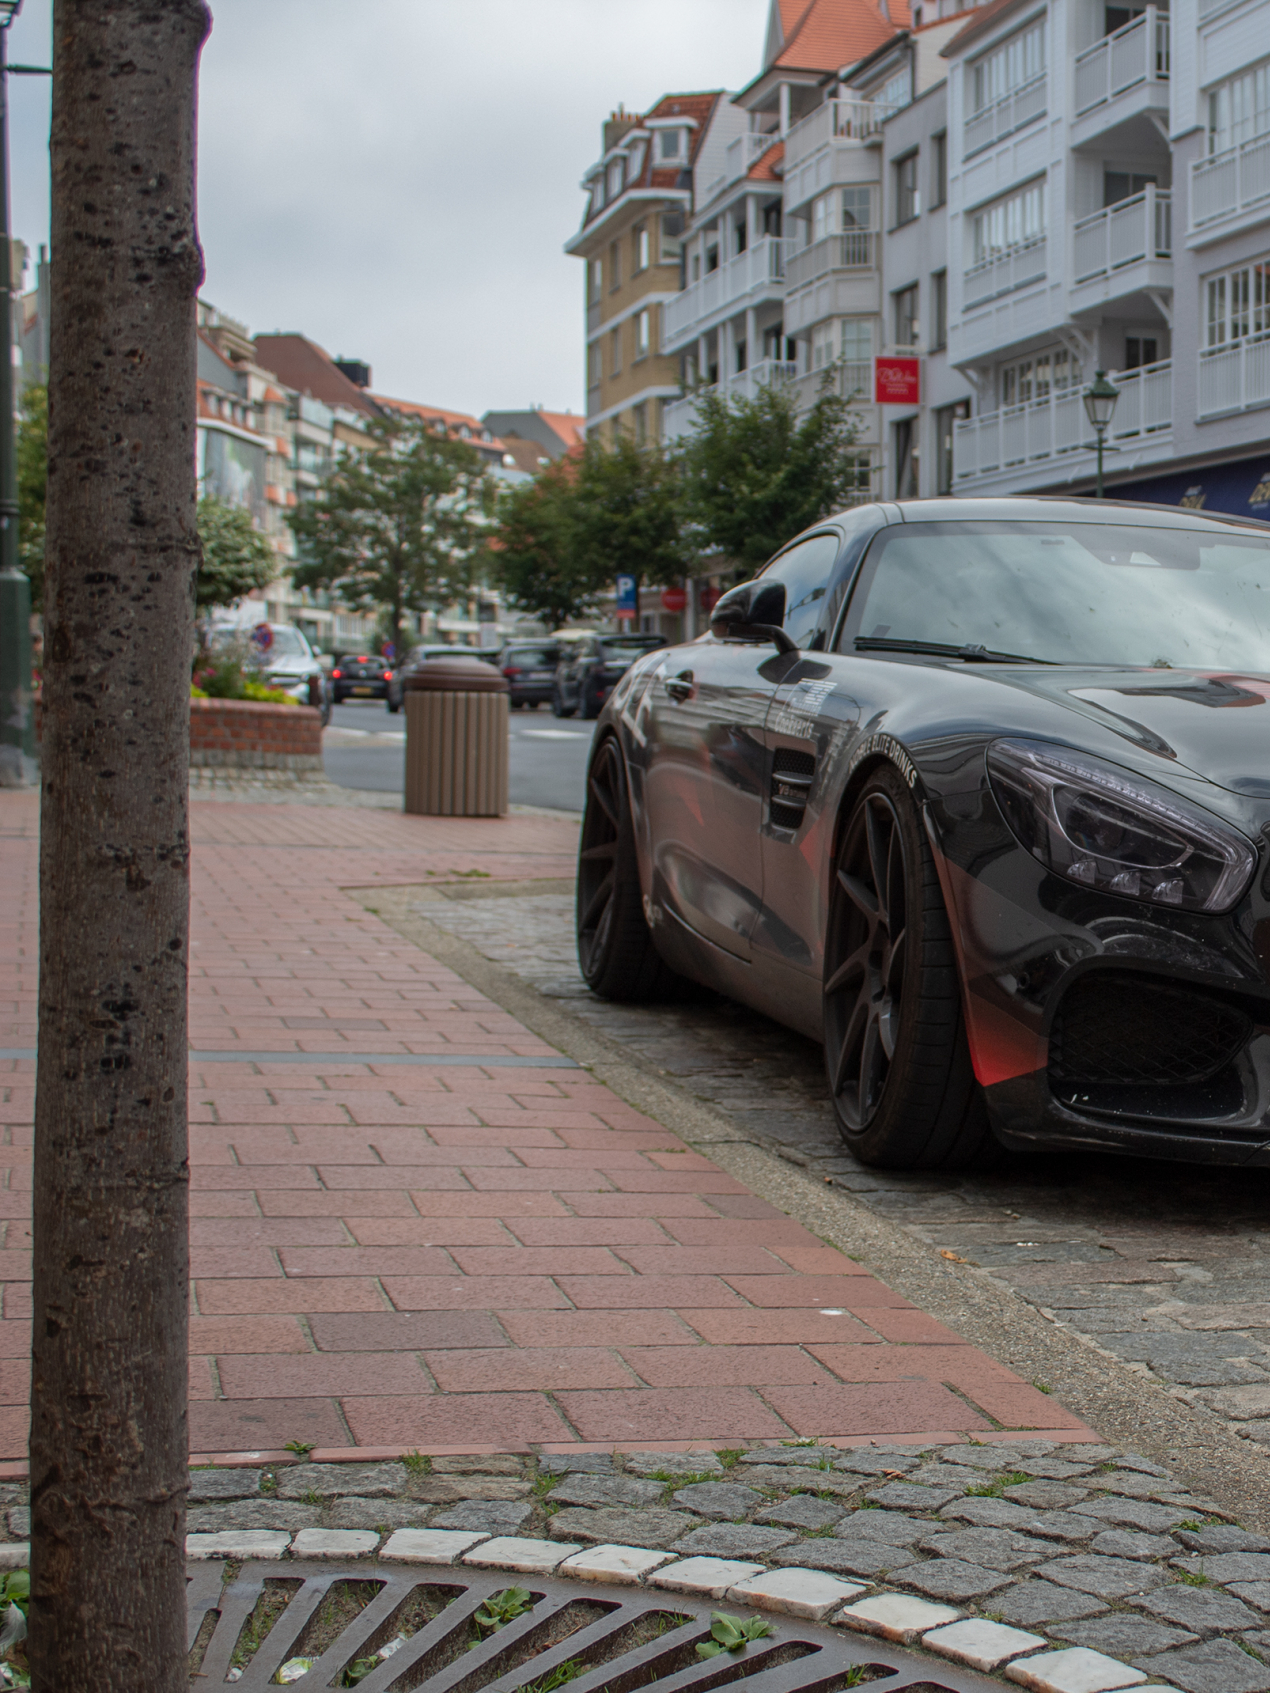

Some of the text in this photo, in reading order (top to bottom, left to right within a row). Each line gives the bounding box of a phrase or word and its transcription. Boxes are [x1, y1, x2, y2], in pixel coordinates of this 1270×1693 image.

[618, 577, 634, 599] P
[872, 734, 891, 754] ELITE
[889, 739, 918, 788] DRINKS
